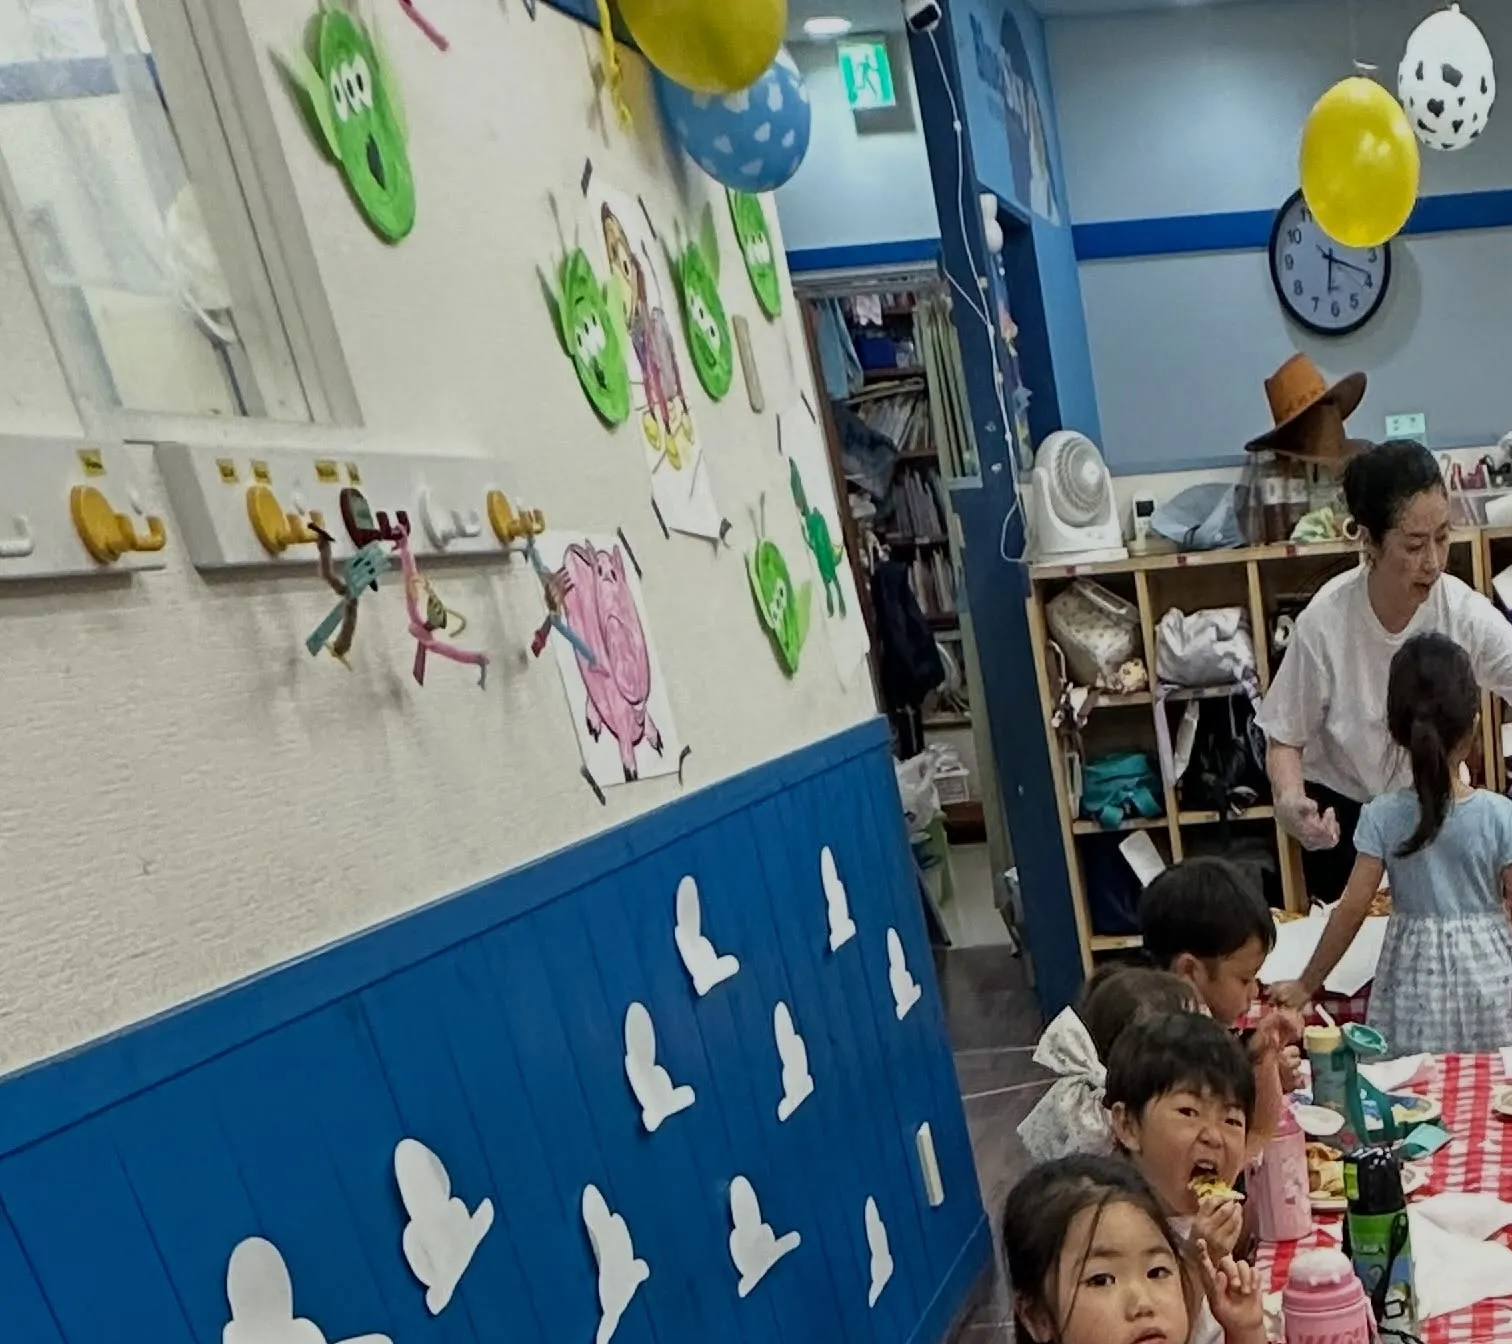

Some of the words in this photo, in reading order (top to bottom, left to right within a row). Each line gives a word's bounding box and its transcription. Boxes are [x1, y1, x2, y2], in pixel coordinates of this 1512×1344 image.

[1287, 228, 1302, 244] 10
[1285, 254, 1294, 270] 9
[1368, 248, 1377, 263] 3
[1293, 279, 1303, 295] 8
[1364, 273, 1373, 288] 4
[1311, 296, 1319, 312] 7
[1331, 301, 1340, 317] 6
[1350, 293, 1359, 309] 5
